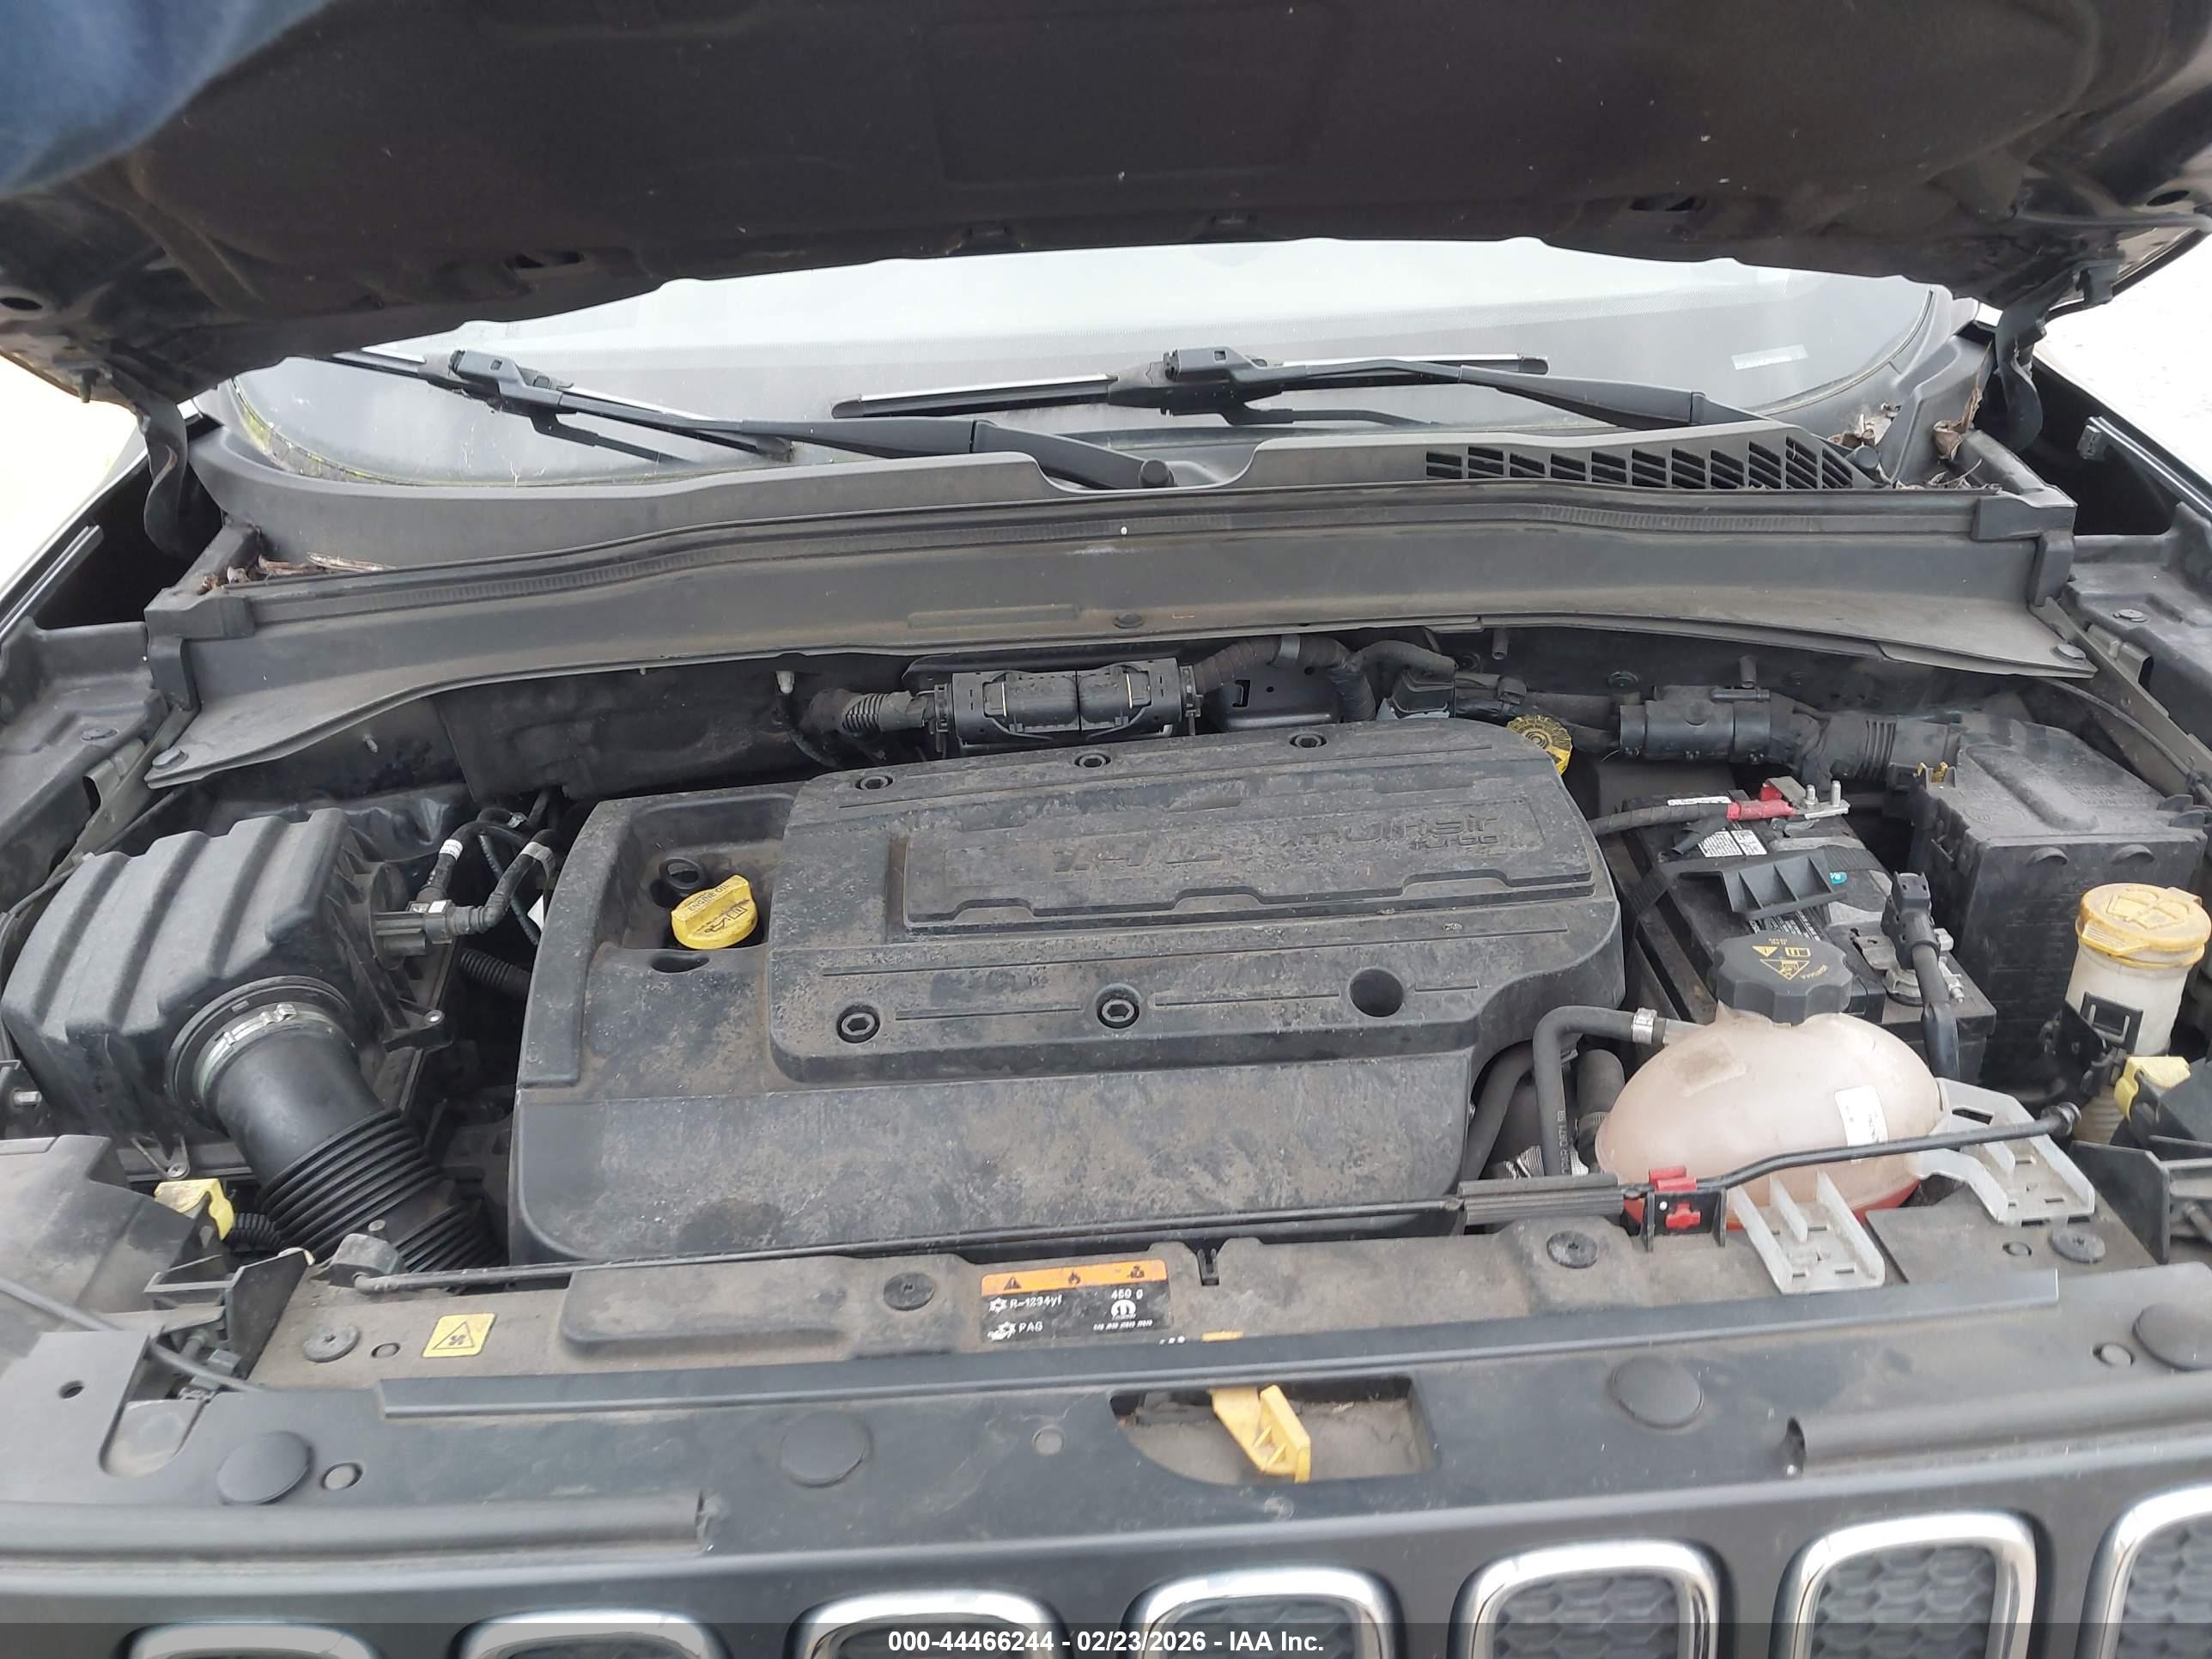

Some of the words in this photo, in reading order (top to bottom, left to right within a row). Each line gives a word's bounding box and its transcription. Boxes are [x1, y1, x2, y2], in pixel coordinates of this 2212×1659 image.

[687, 890, 717, 912] ENGINE
[715, 883, 732, 894] OIL
[1018, 1320, 1044, 1334] PAG
